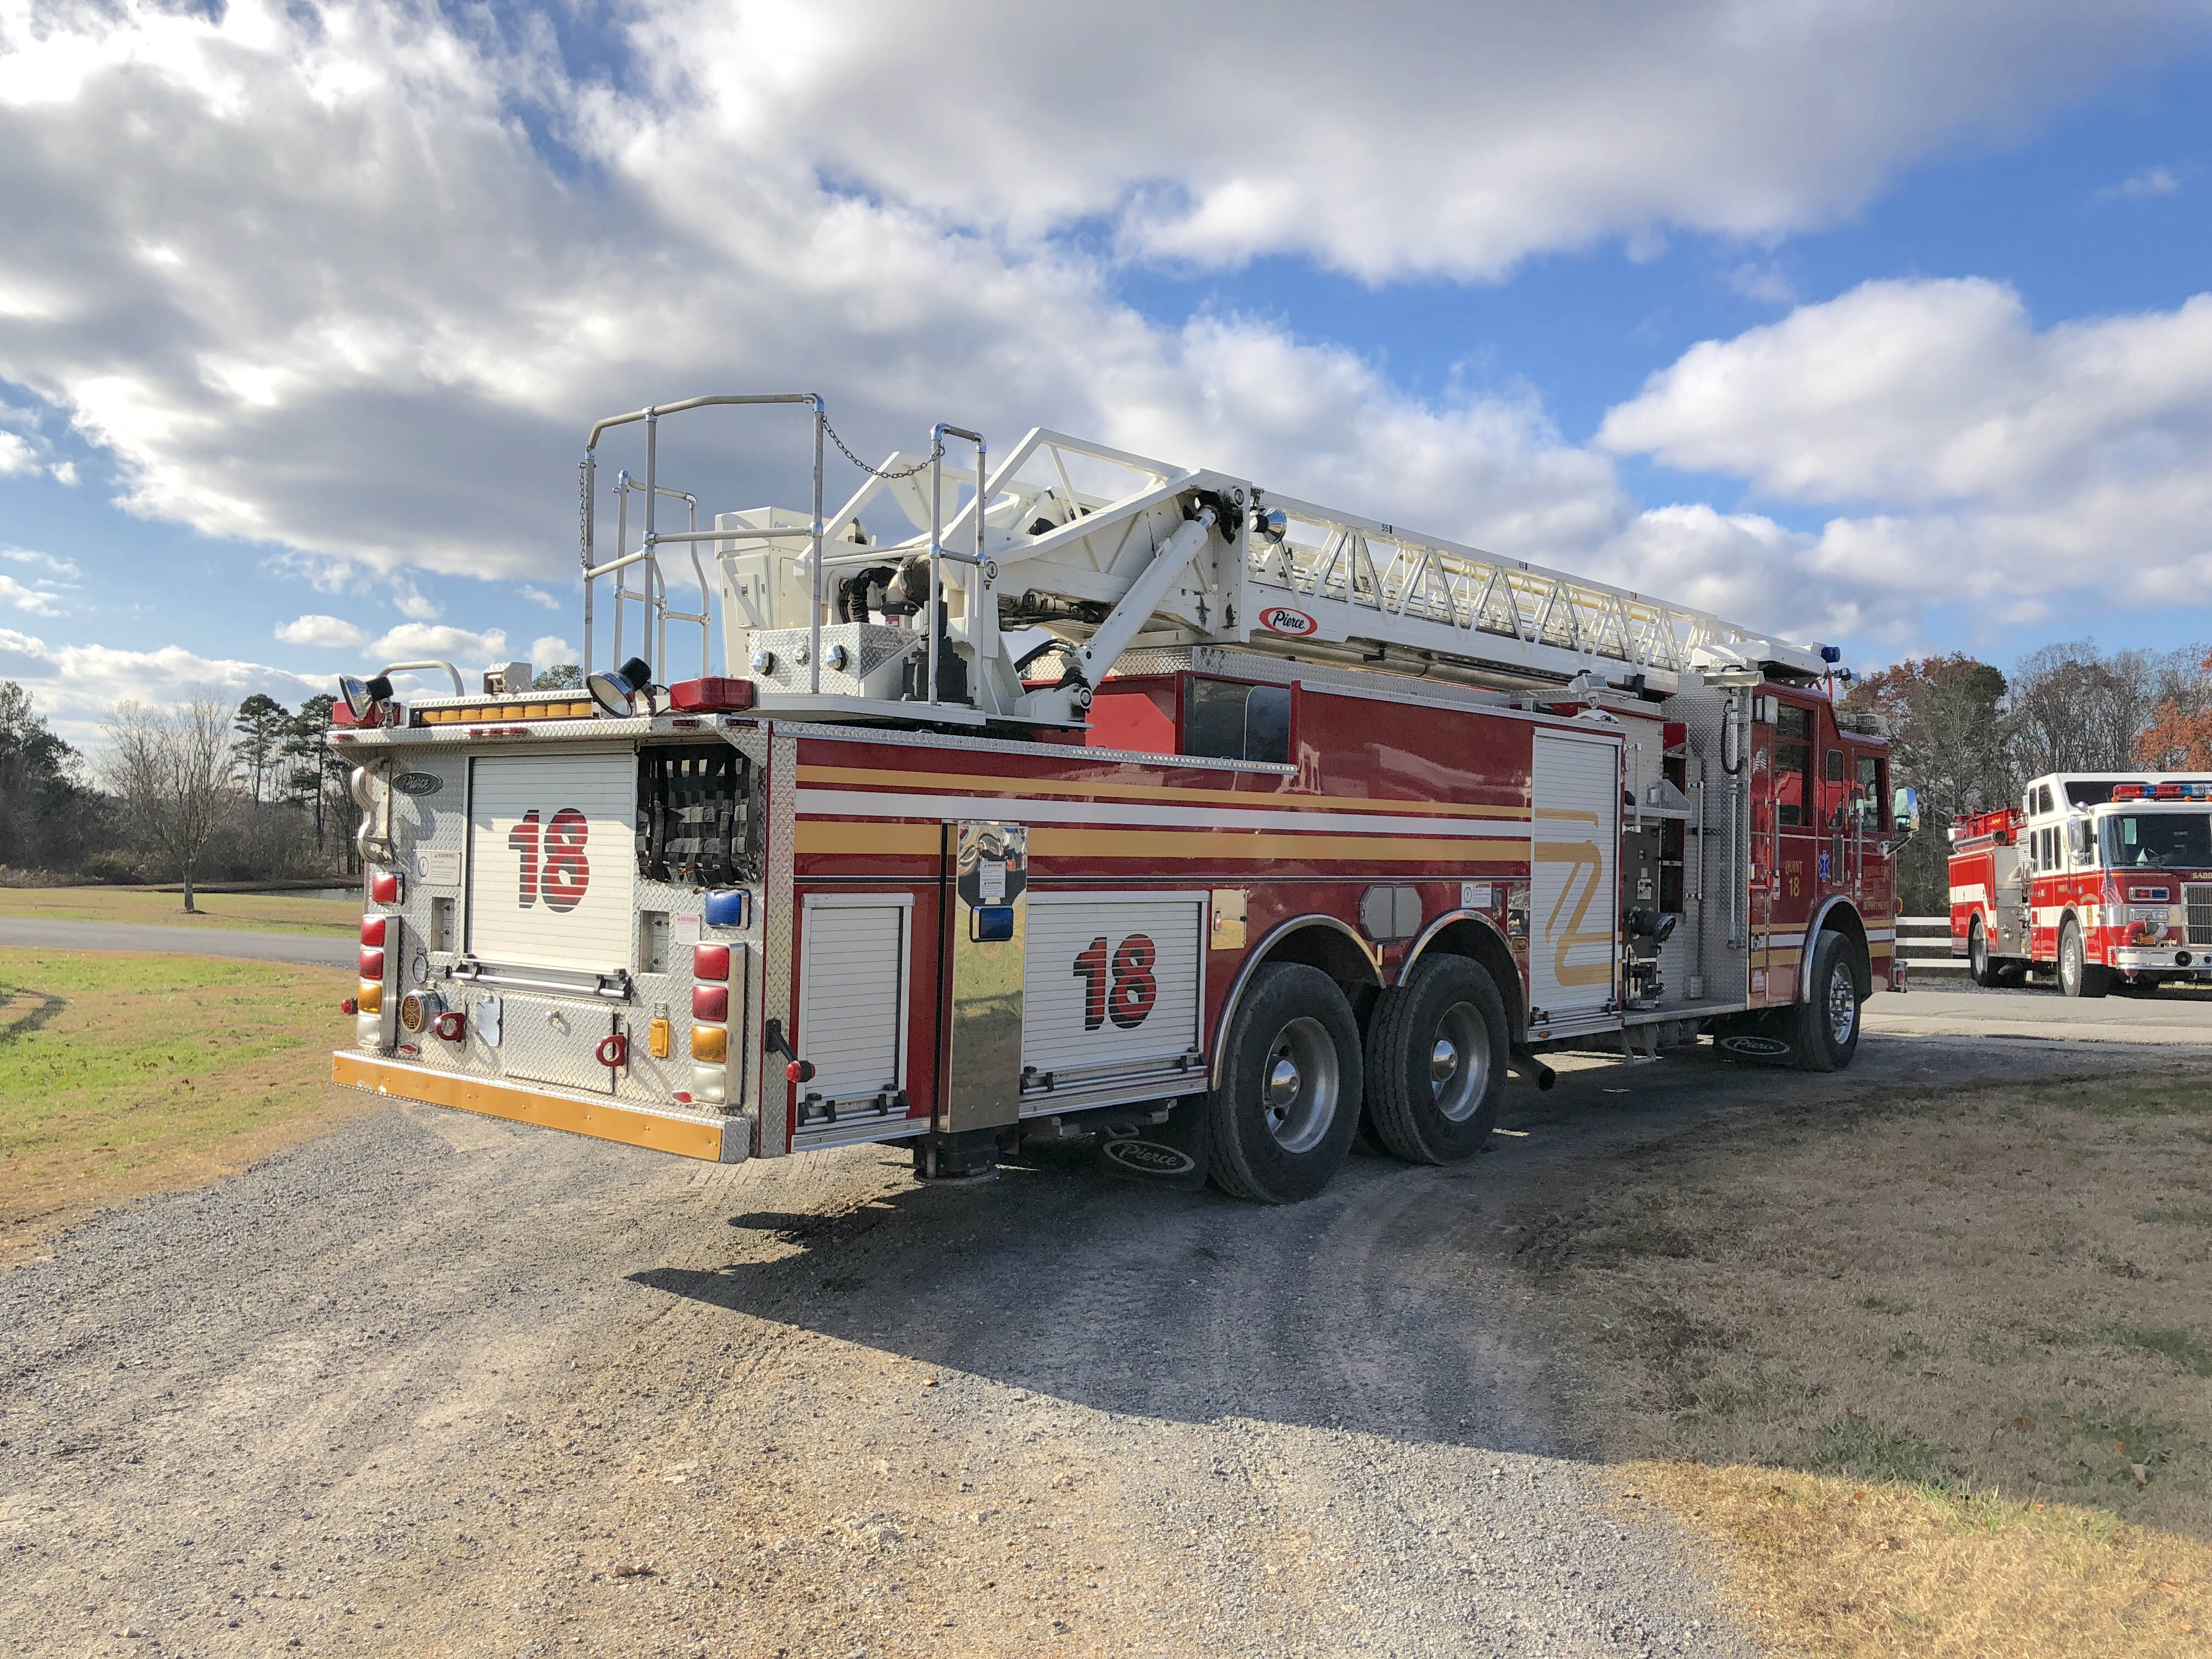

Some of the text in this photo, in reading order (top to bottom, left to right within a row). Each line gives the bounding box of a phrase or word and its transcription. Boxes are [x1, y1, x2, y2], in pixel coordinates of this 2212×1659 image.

[1381, 523, 1389, 532] 55
[1519, 561, 1525, 569] 65
[1273, 610, 1305, 629] Pierce
[402, 775, 431, 791] Pierce
[508, 808, 590, 913] 18
[1785, 860, 1803, 876] QUINT
[1788, 877, 1800, 897] 18
[1073, 934, 1156, 1031] 18
[1119, 1143, 1177, 1166] Pierce
